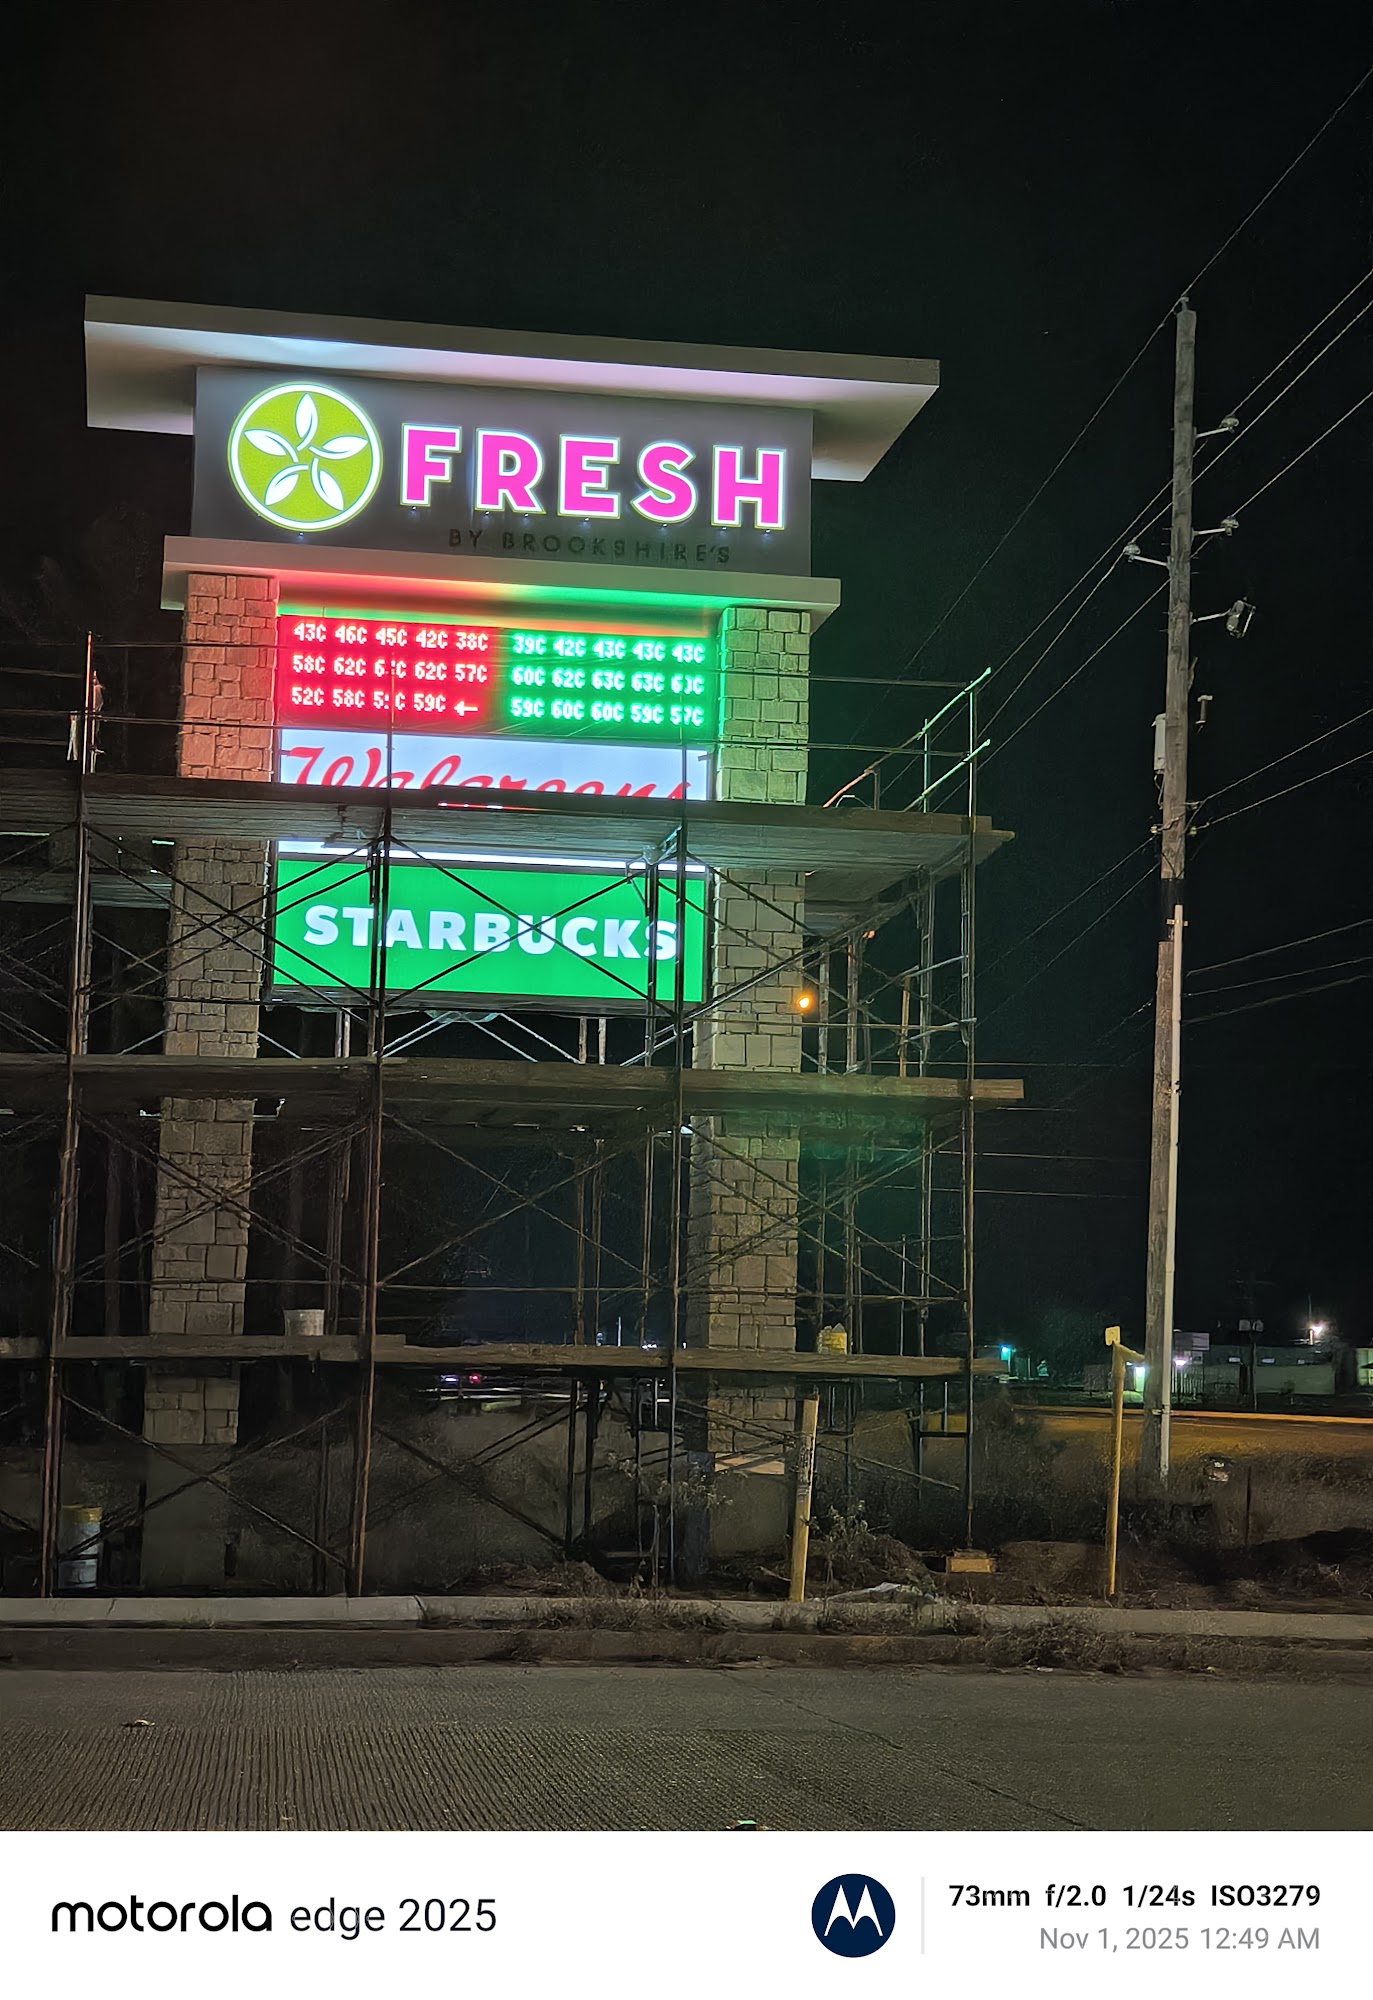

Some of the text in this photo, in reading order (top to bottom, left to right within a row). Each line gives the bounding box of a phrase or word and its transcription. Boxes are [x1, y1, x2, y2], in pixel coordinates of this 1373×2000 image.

[400, 422, 786, 530] FRESH
[448, 528, 731, 563] BY BROOKSHIRE'S
[294, 623, 488, 651] 43C 46C 45C 42C 38C
[515, 636, 703, 663] 39C 42C 43C 43C 43C
[293, 655, 487, 682] 58C 62C 6C 62C 57C
[513, 667, 544, 686] 60C
[553, 670, 584, 688] 62C
[592, 672, 623, 690] 63C
[632, 674, 663, 692] 63C
[292, 687, 324, 705] 52C
[333, 689, 364, 708] 58C
[414, 693, 445, 712] 59C
[512, 699, 543, 717] 59C
[552, 701, 583, 719] 60C
[592, 703, 622, 721] 60C
[631, 705, 662, 723] 59C
[303, 904, 681, 961] STARBUCKS
